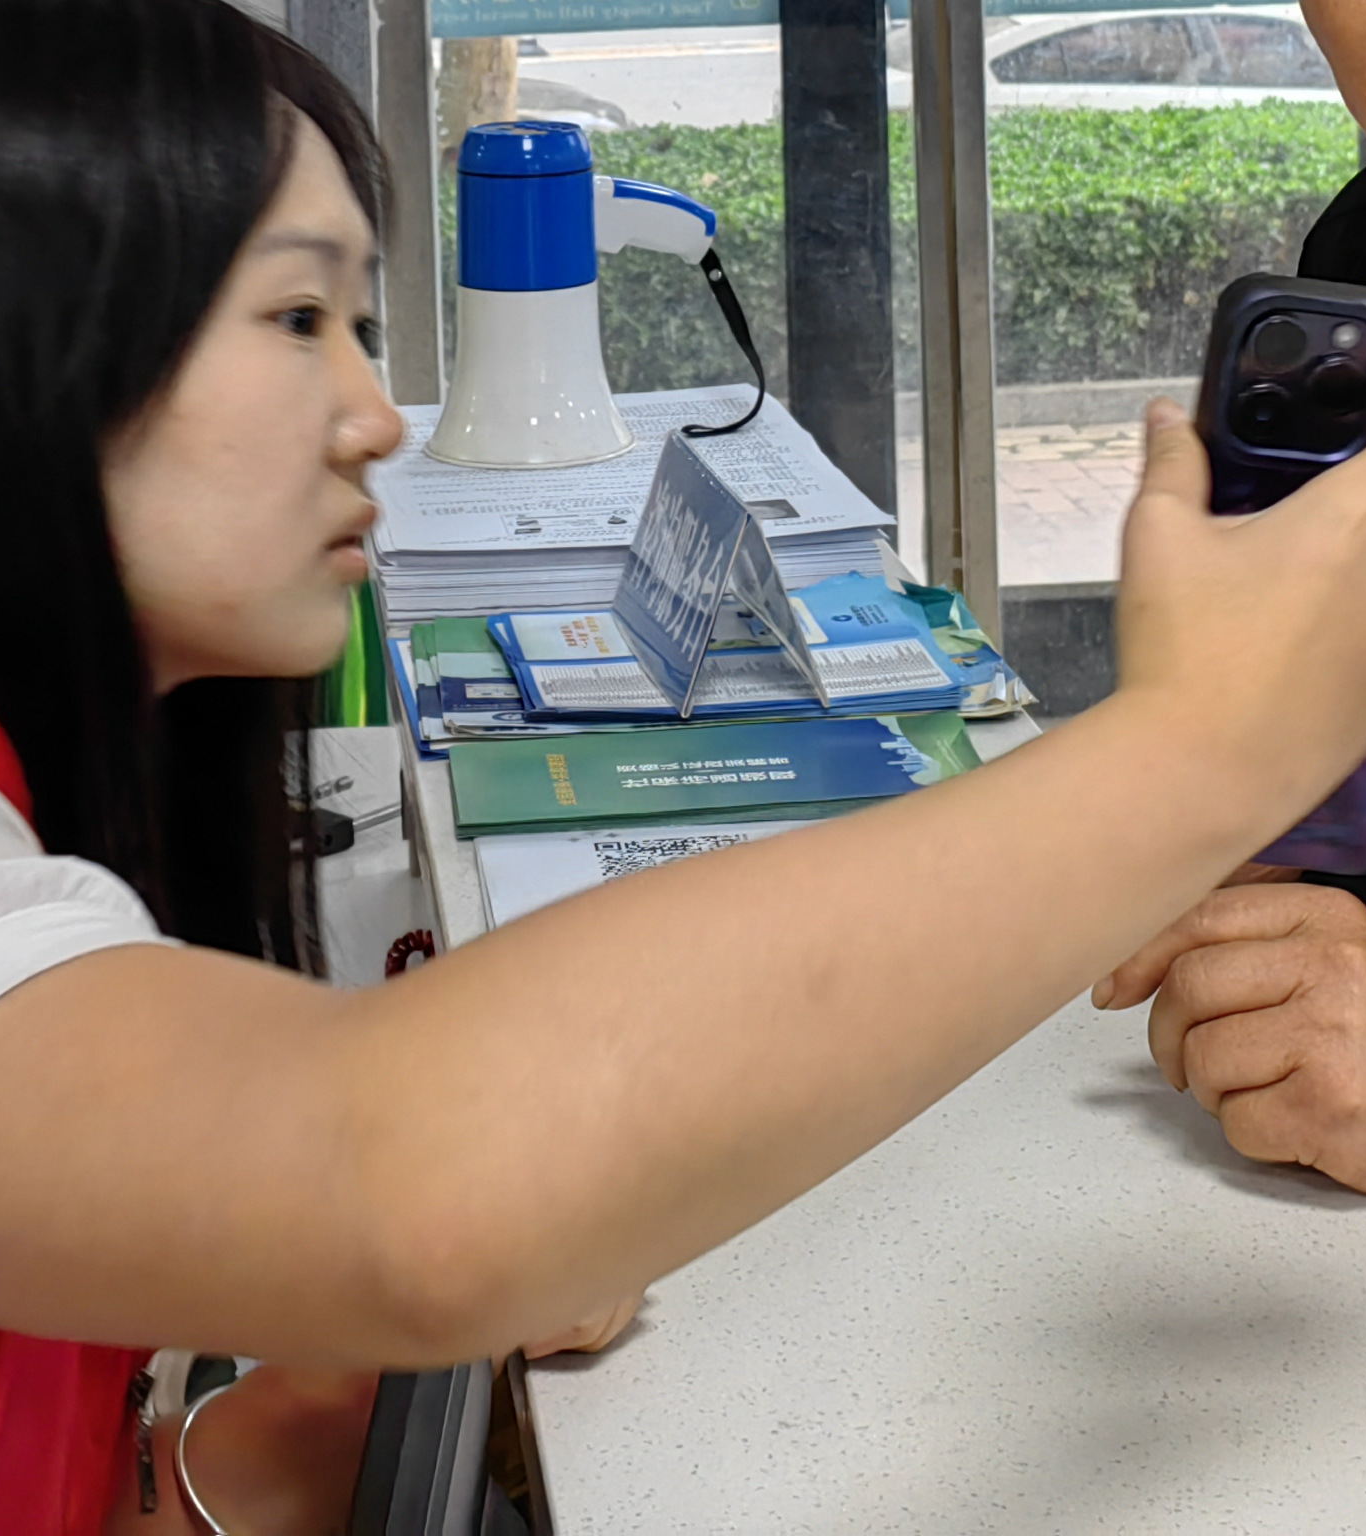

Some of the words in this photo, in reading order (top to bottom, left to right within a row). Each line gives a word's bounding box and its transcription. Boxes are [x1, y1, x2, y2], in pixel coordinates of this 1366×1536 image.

[631, 480, 724, 662] 咨询服务台
